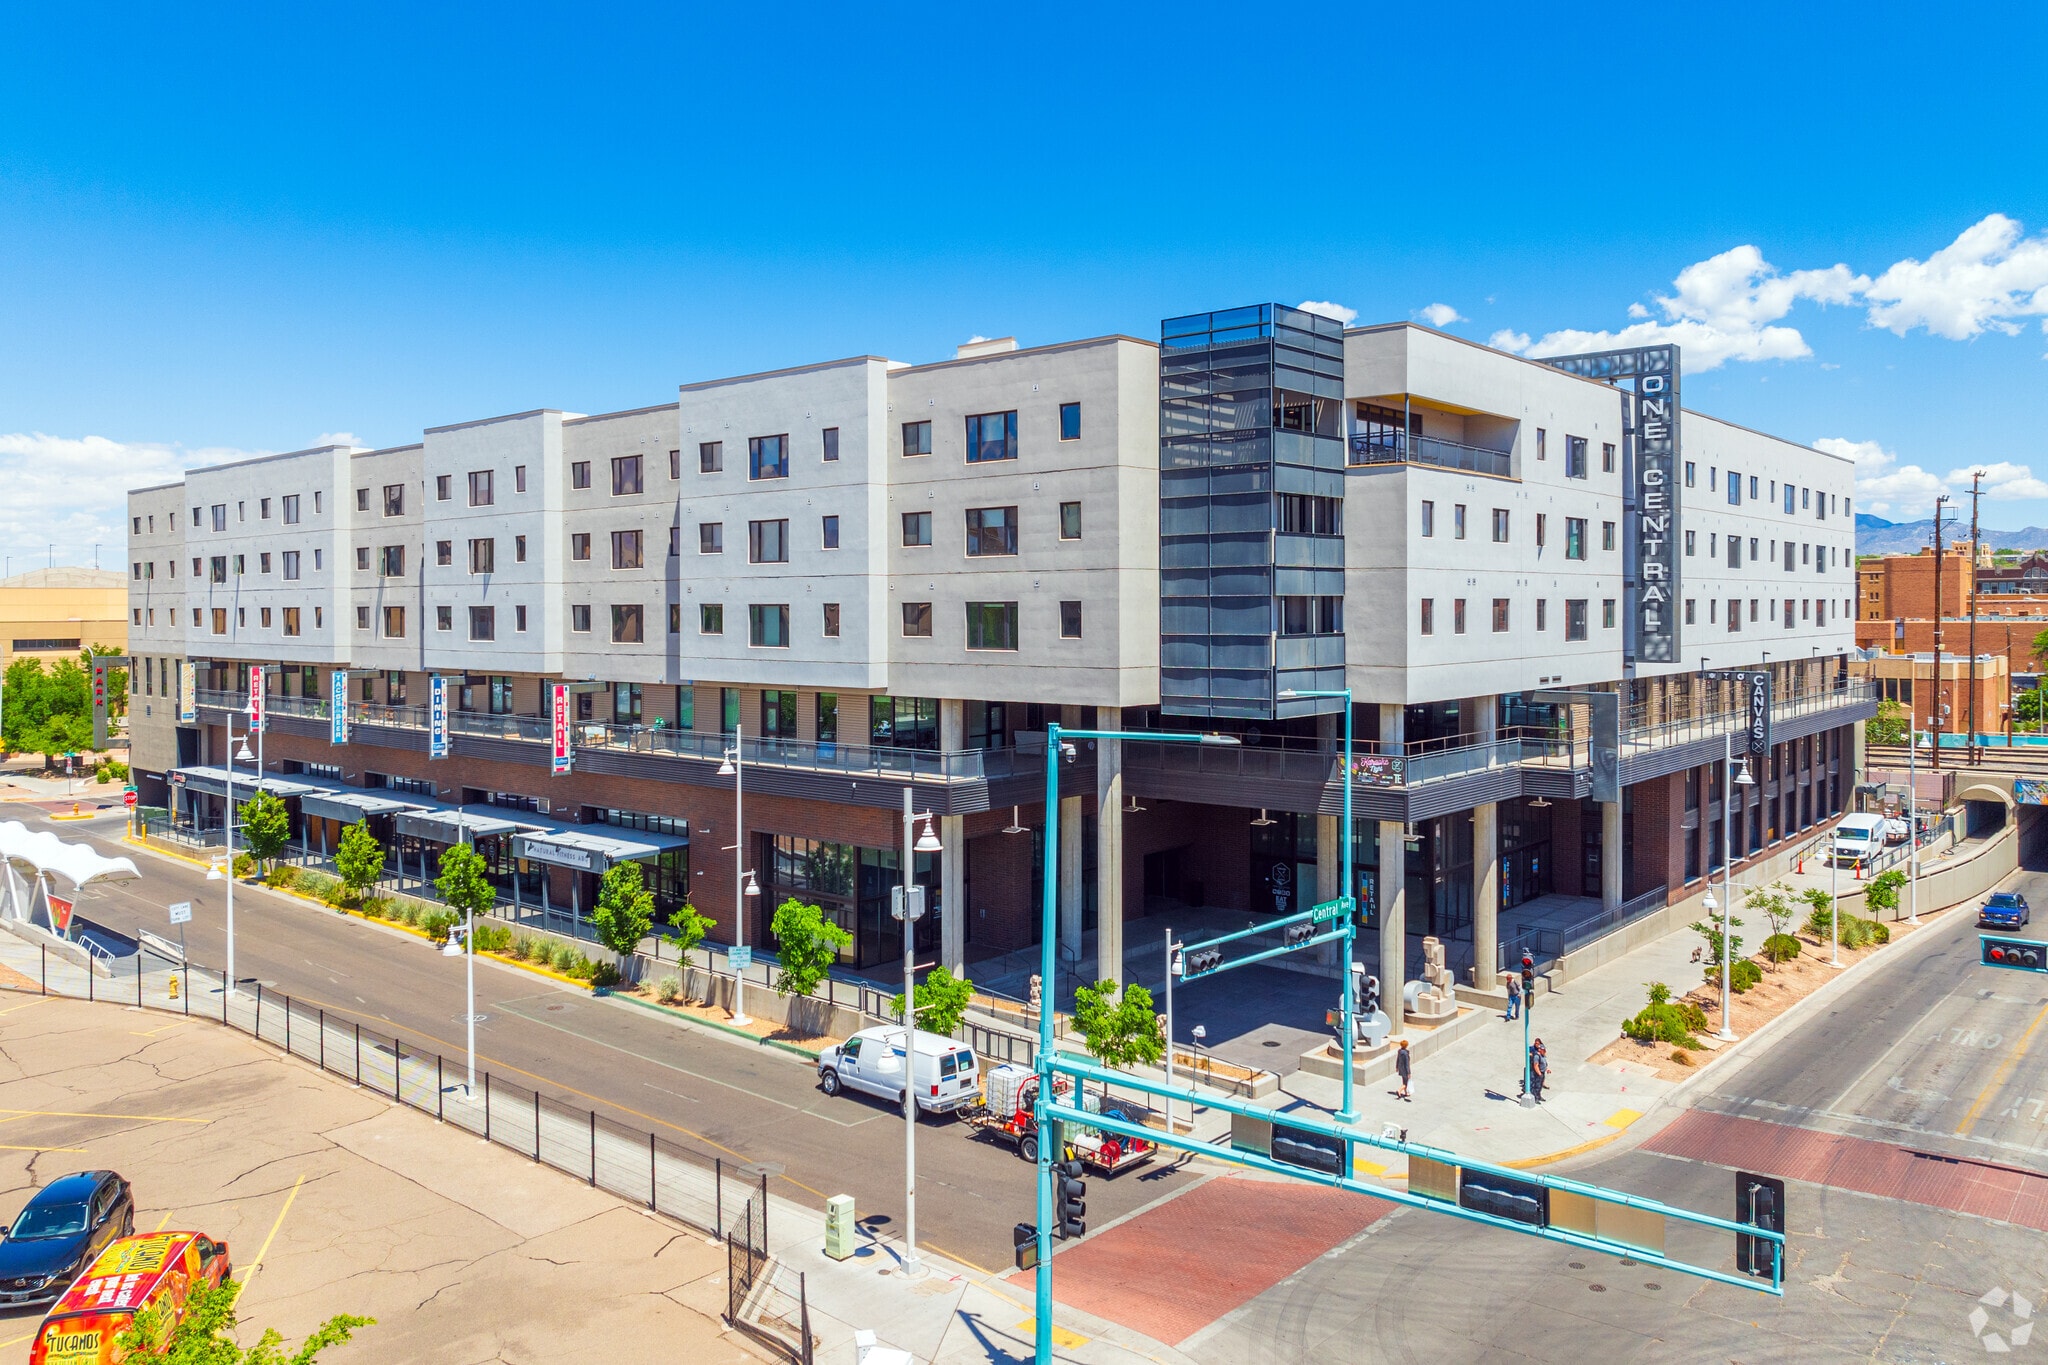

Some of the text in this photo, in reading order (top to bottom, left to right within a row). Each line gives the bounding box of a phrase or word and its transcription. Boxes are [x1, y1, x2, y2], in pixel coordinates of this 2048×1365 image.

[1642, 375, 1664, 626] ONE CENTRAL
[95, 667, 103, 706] PARK
[1753, 675, 1765, 739] CANVAS
[556, 696, 564, 748] RETAIL
[1313, 902, 1339, 921] Central
[47, 1333, 99, 1352] TUCANOS
